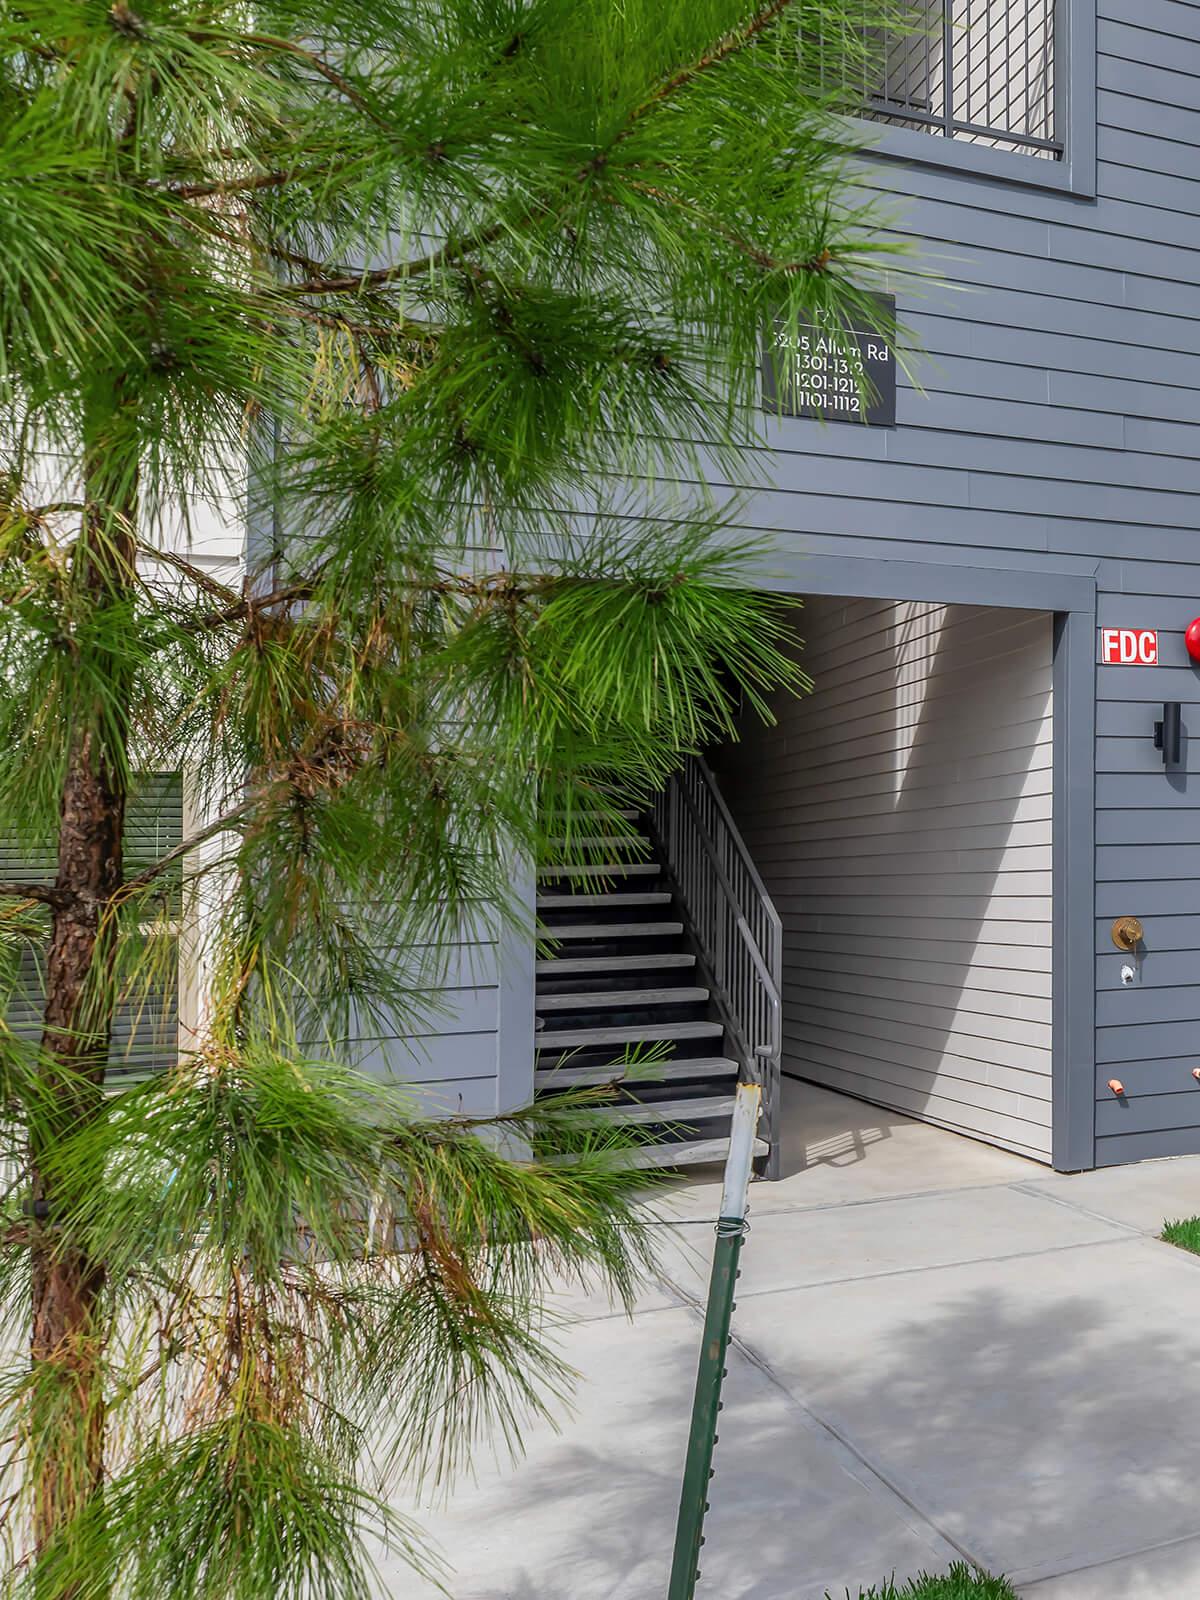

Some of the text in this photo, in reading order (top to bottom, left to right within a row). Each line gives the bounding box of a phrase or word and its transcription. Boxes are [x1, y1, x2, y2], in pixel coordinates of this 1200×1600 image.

[867, 344, 889, 362] Rd
[799, 391, 860, 412] 1101-1112
[1103, 629, 1156, 663] FDC
